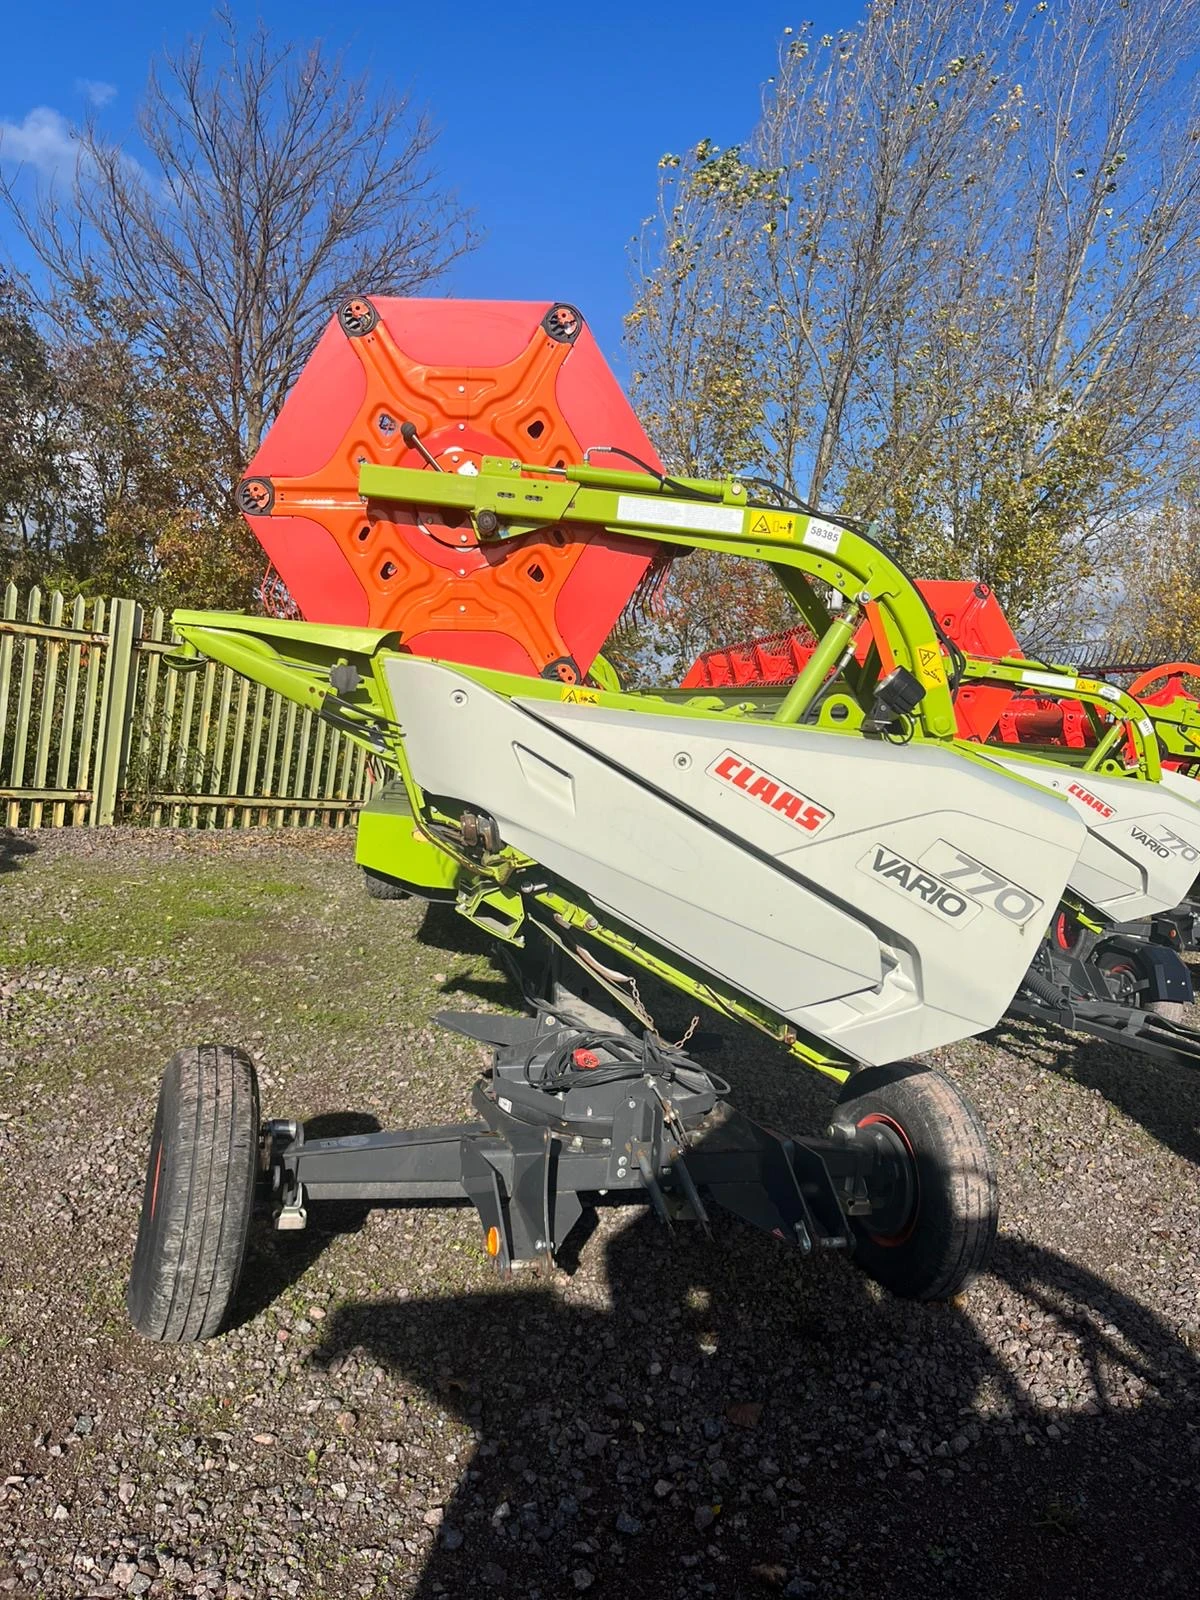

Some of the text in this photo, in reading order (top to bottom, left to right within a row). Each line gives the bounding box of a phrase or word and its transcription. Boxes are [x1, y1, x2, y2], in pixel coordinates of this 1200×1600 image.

[810, 526, 839, 542] 58385
[714, 756, 826, 832] CLAAS
[1068, 784, 1114, 818] CLAAS
[1130, 827, 1170, 859] VARIO
[1159, 831, 1199, 861] 770
[871, 848, 968, 918] VARIO
[939, 853, 1038, 921] 770
